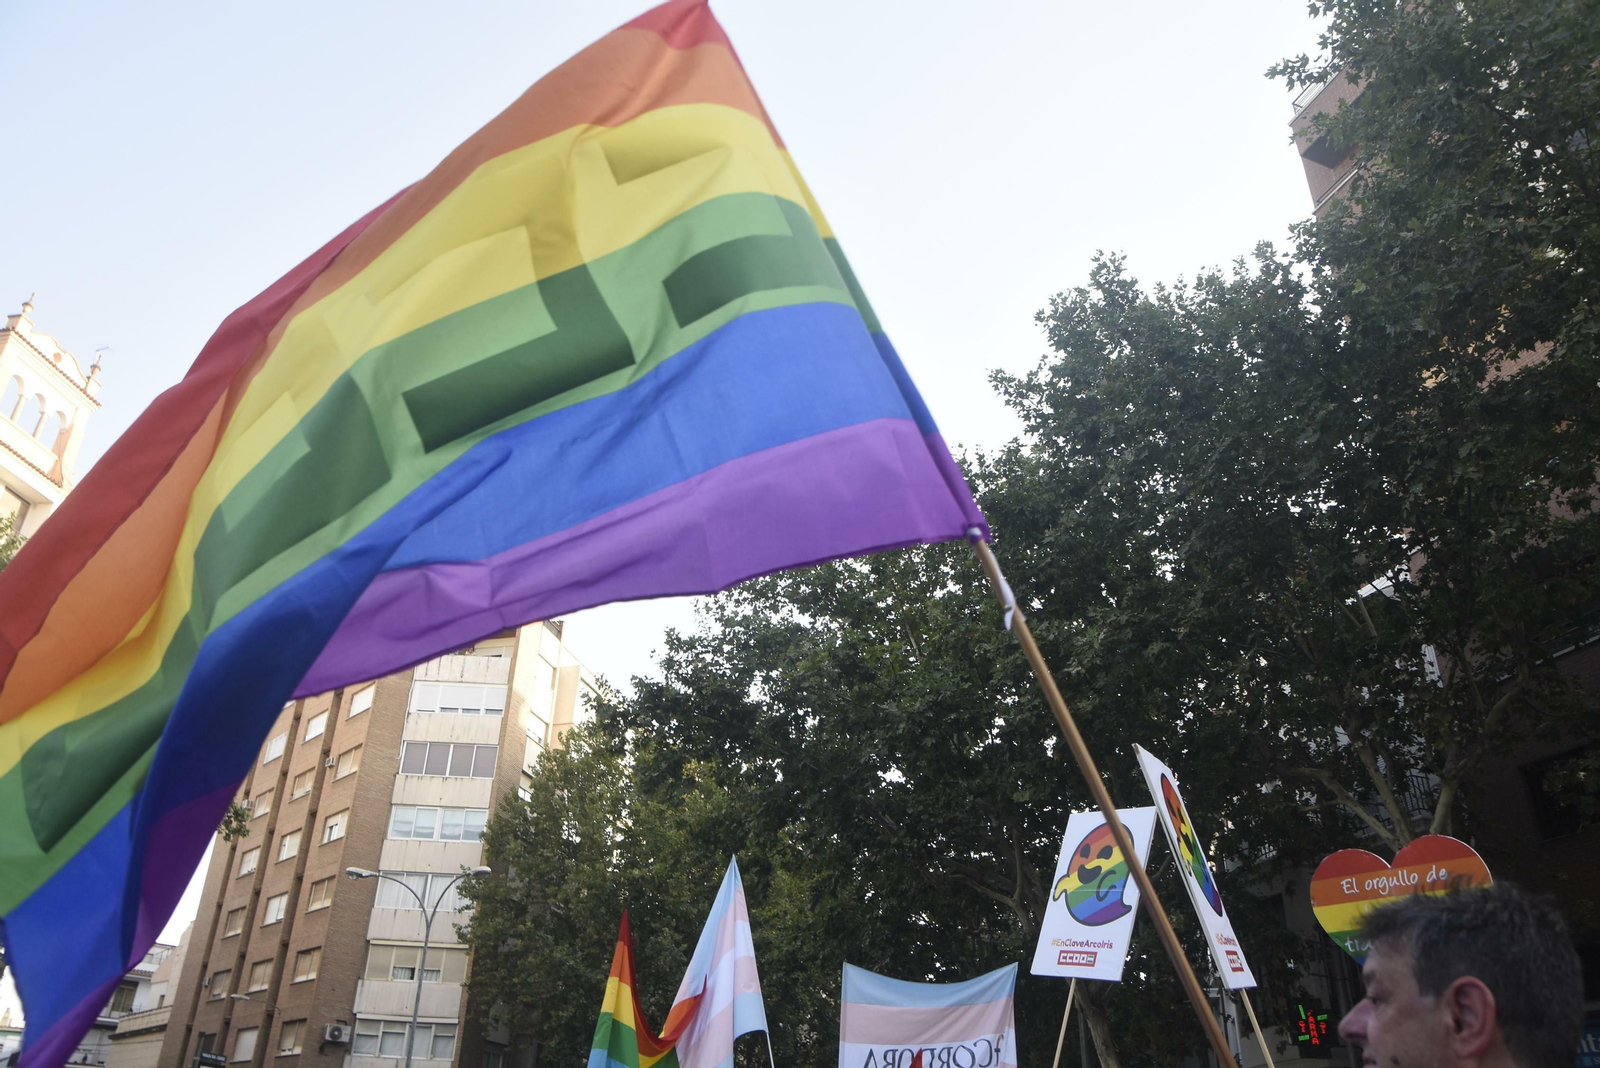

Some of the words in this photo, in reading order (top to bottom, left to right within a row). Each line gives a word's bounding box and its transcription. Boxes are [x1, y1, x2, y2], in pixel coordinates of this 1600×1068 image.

[1340, 877, 1359, 894] El
[1364, 869, 1419, 895] orgullo
[1426, 864, 1448, 883] de
[1051, 938, 1114, 949] #EnClaveArcoIris
